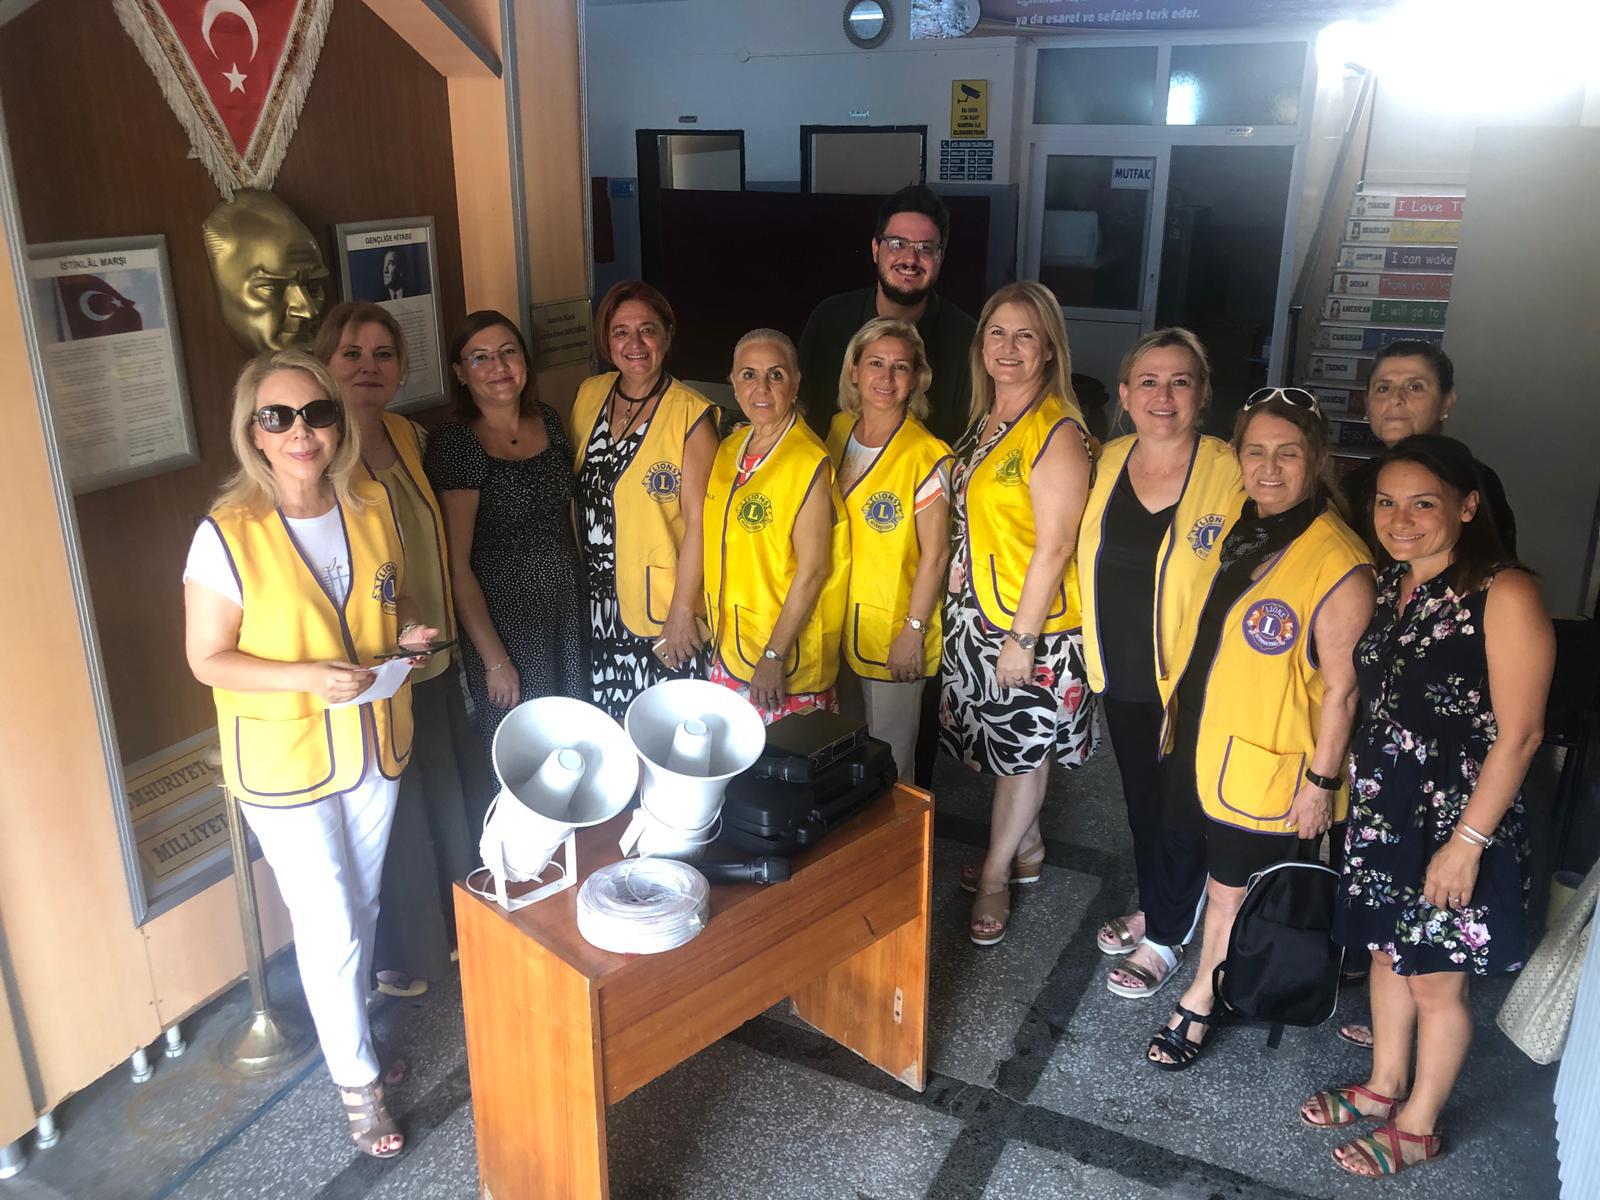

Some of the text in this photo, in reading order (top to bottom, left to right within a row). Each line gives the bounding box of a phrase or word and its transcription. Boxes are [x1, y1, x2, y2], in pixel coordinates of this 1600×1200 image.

[1016, 7, 1200, 28] ya da esaret ve sefalete terk eder.
[1114, 167, 1151, 180] MUTFAK
[1398, 200, 1406, 212] I
[1411, 200, 1443, 213] Love
[100, 256, 127, 267] MARŞI
[1391, 251, 1454, 265] I can wake
[1381, 303, 1440, 321] I will go to
[652, 463, 677, 474] LIONS
[659, 475, 669, 490] L
[747, 494, 769, 506] LIONS
[874, 493, 898, 504] LIONS
[748, 504, 758, 520] L
[878, 504, 889, 519] L
[1265, 605, 1286, 618] LIONS
[1262, 616, 1274, 636] L
